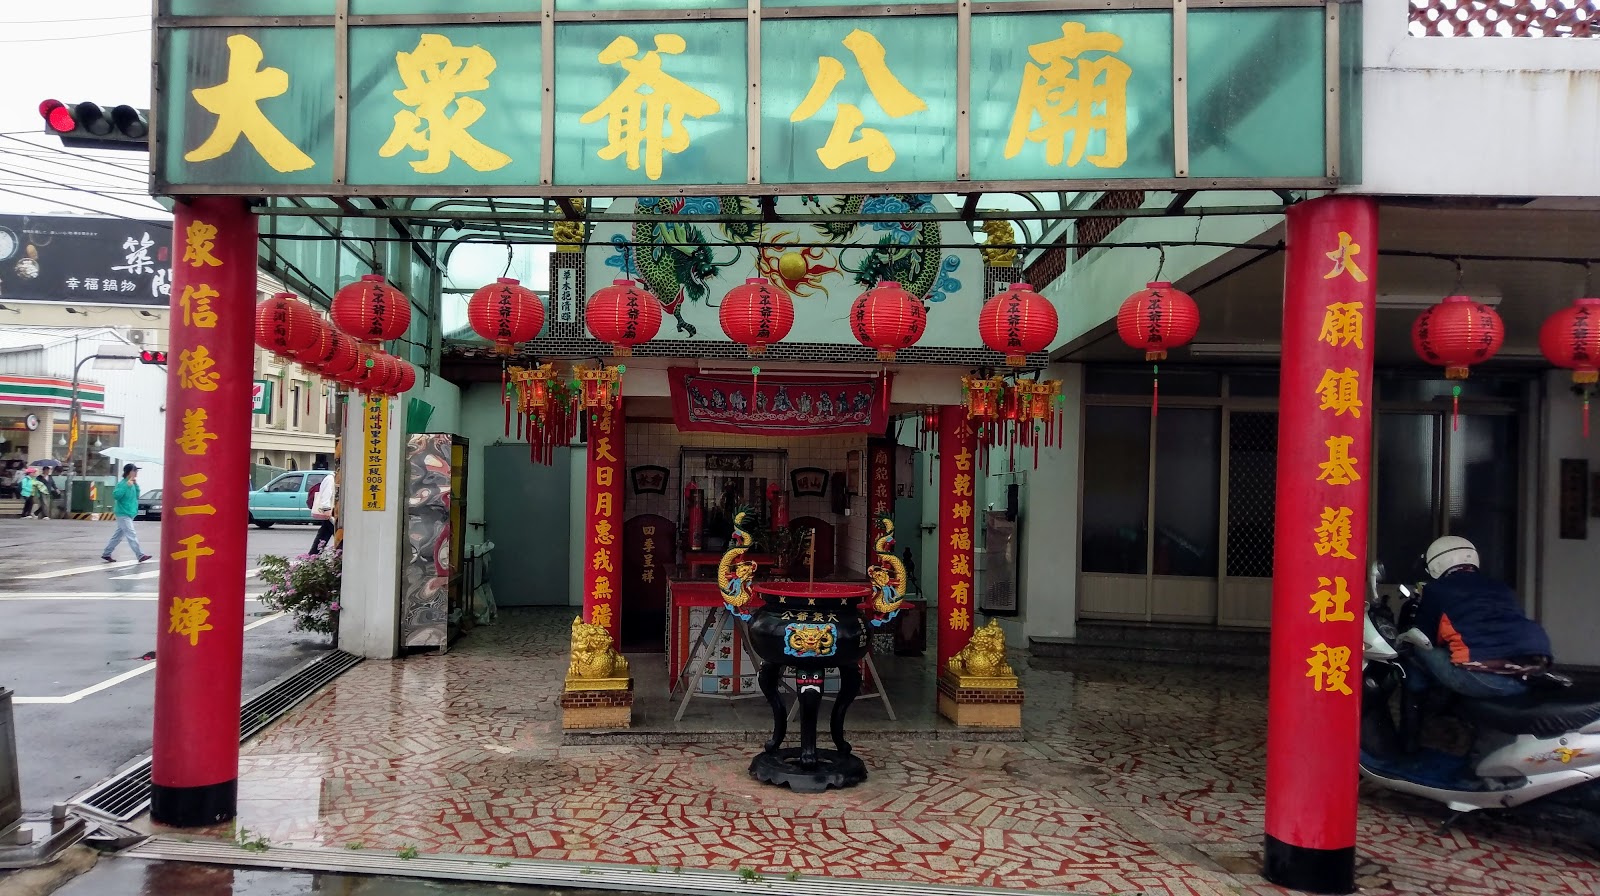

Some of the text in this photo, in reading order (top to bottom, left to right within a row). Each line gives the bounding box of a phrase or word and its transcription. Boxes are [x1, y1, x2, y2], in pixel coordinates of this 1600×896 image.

[65, 277, 137, 292] 幸福鍋物
[641, 525, 656, 584] 四季呈祥
